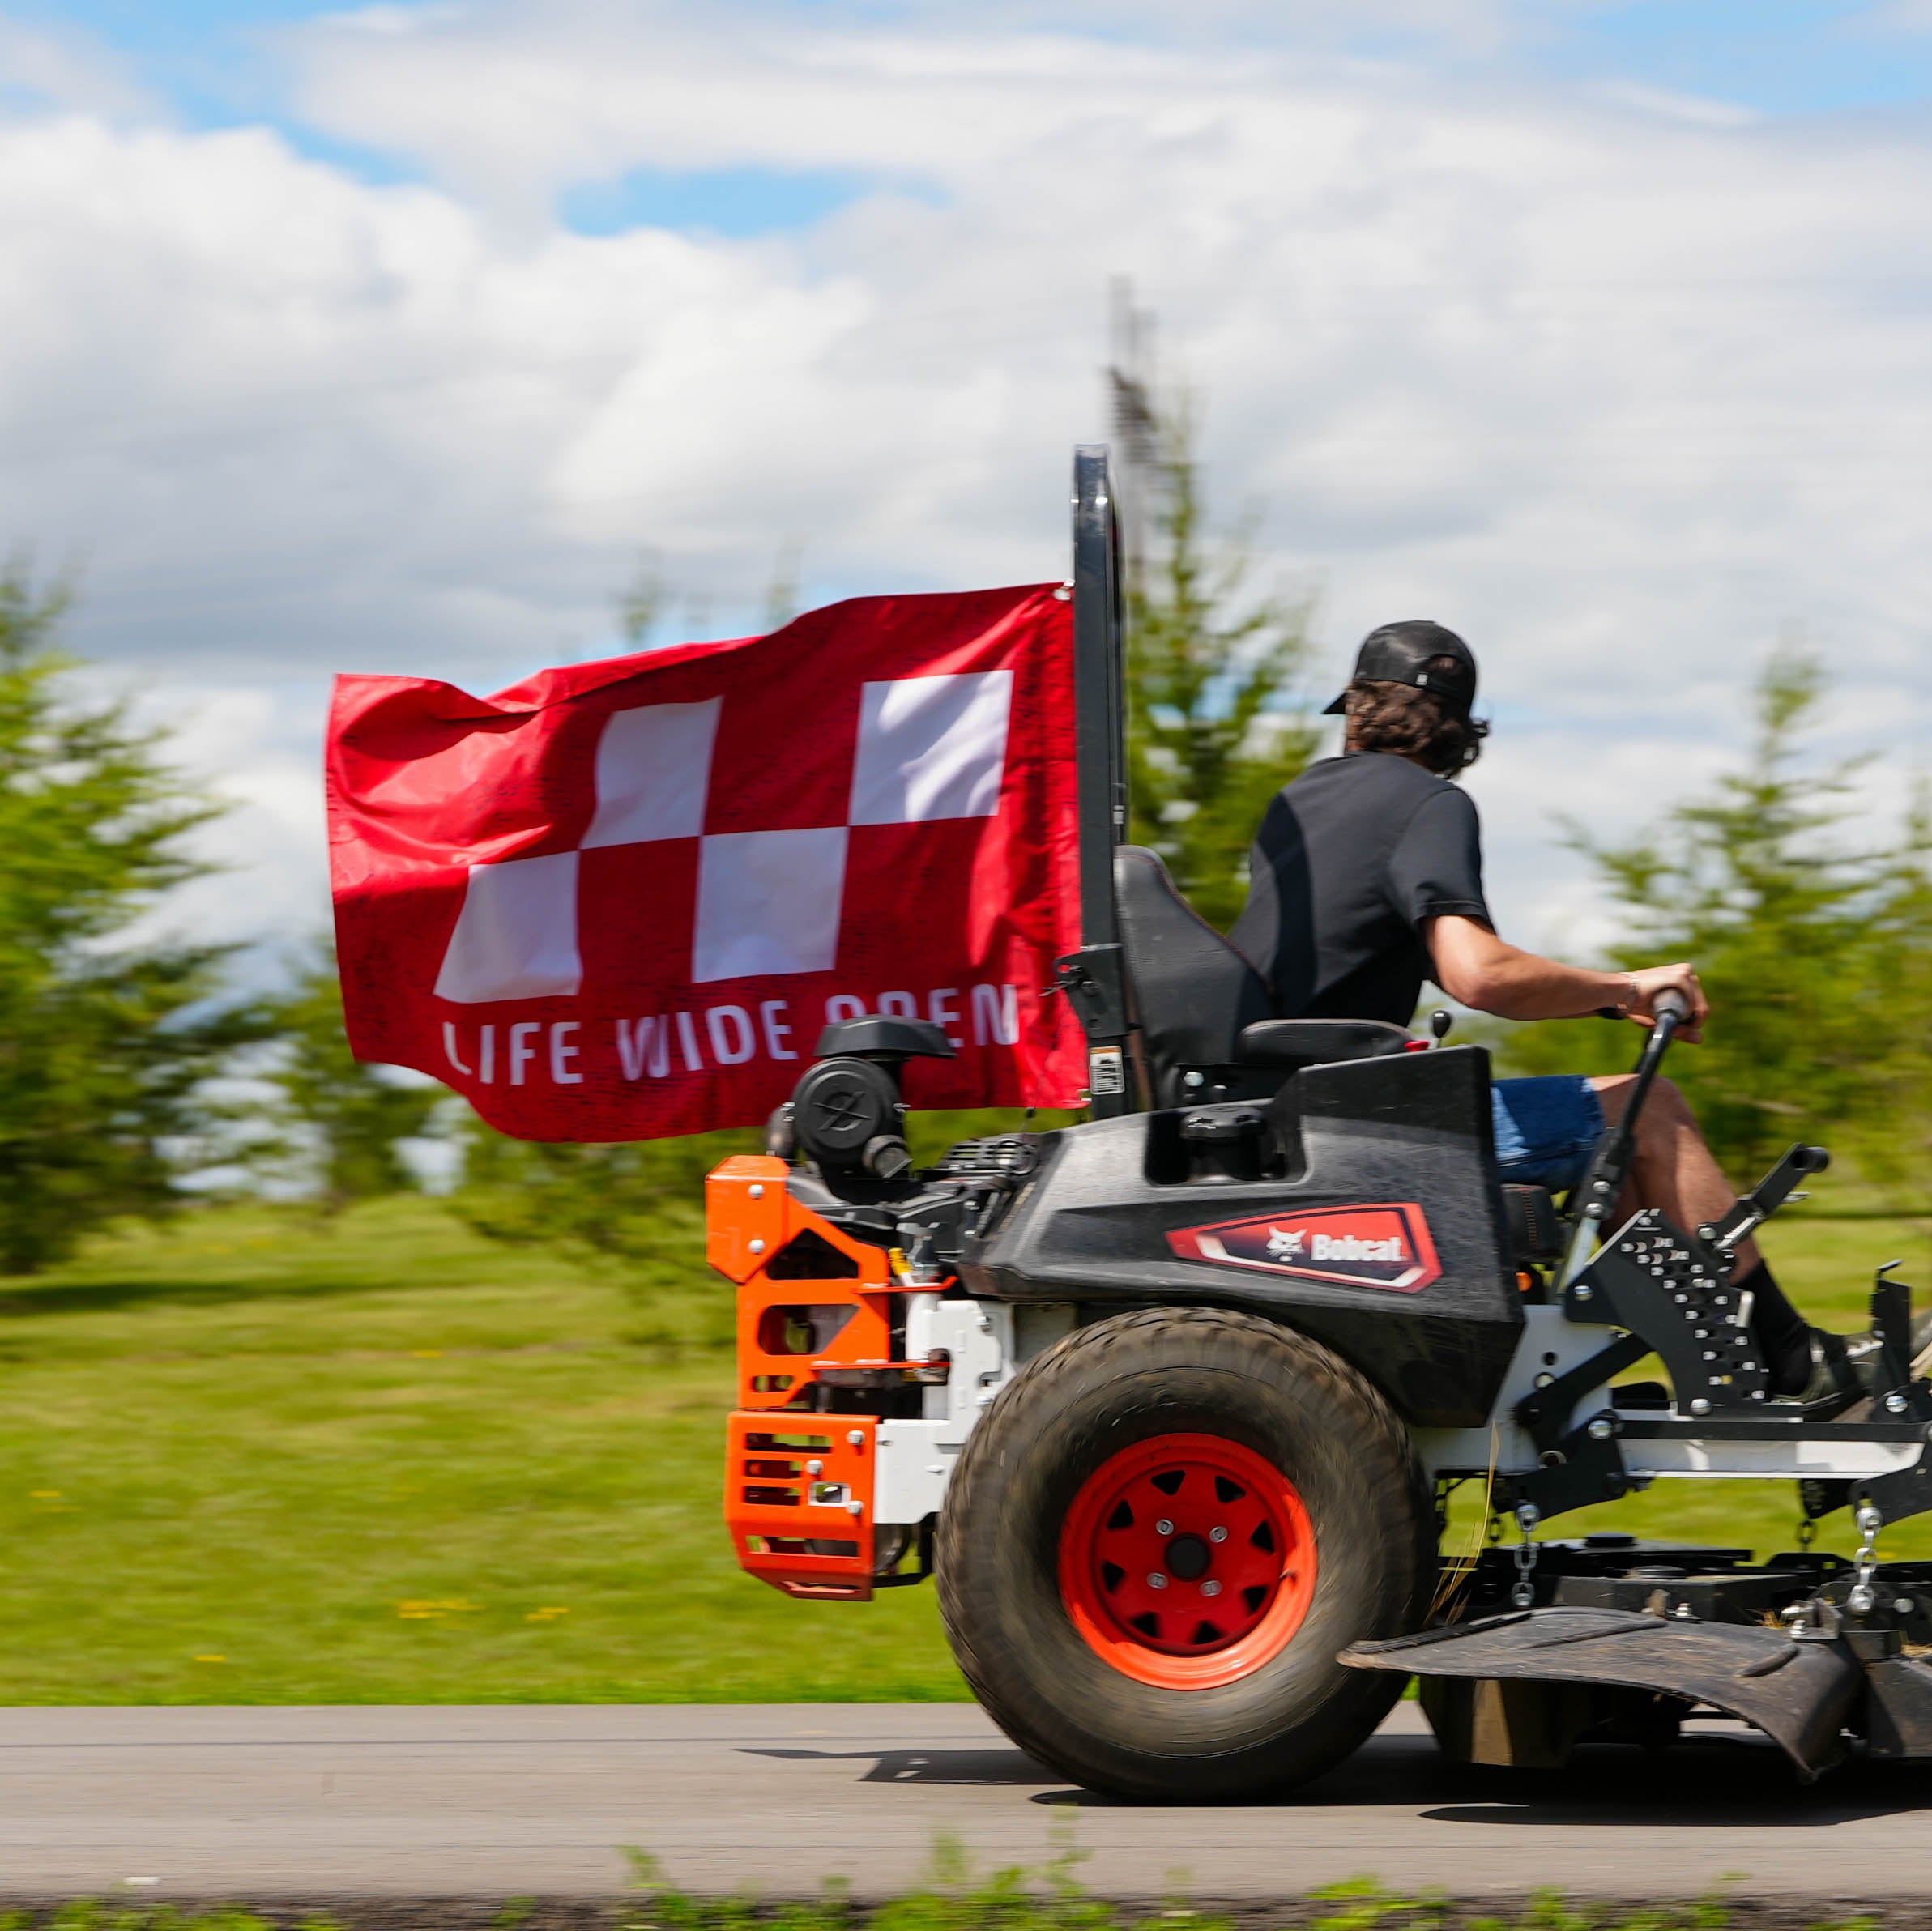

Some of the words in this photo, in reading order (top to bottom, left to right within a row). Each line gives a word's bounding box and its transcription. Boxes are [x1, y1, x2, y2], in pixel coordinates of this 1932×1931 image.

[442, 1021, 584, 1085] LIFE
[616, 1000, 800, 1081] WIDE
[1311, 1234, 1403, 1262] Bobcat
